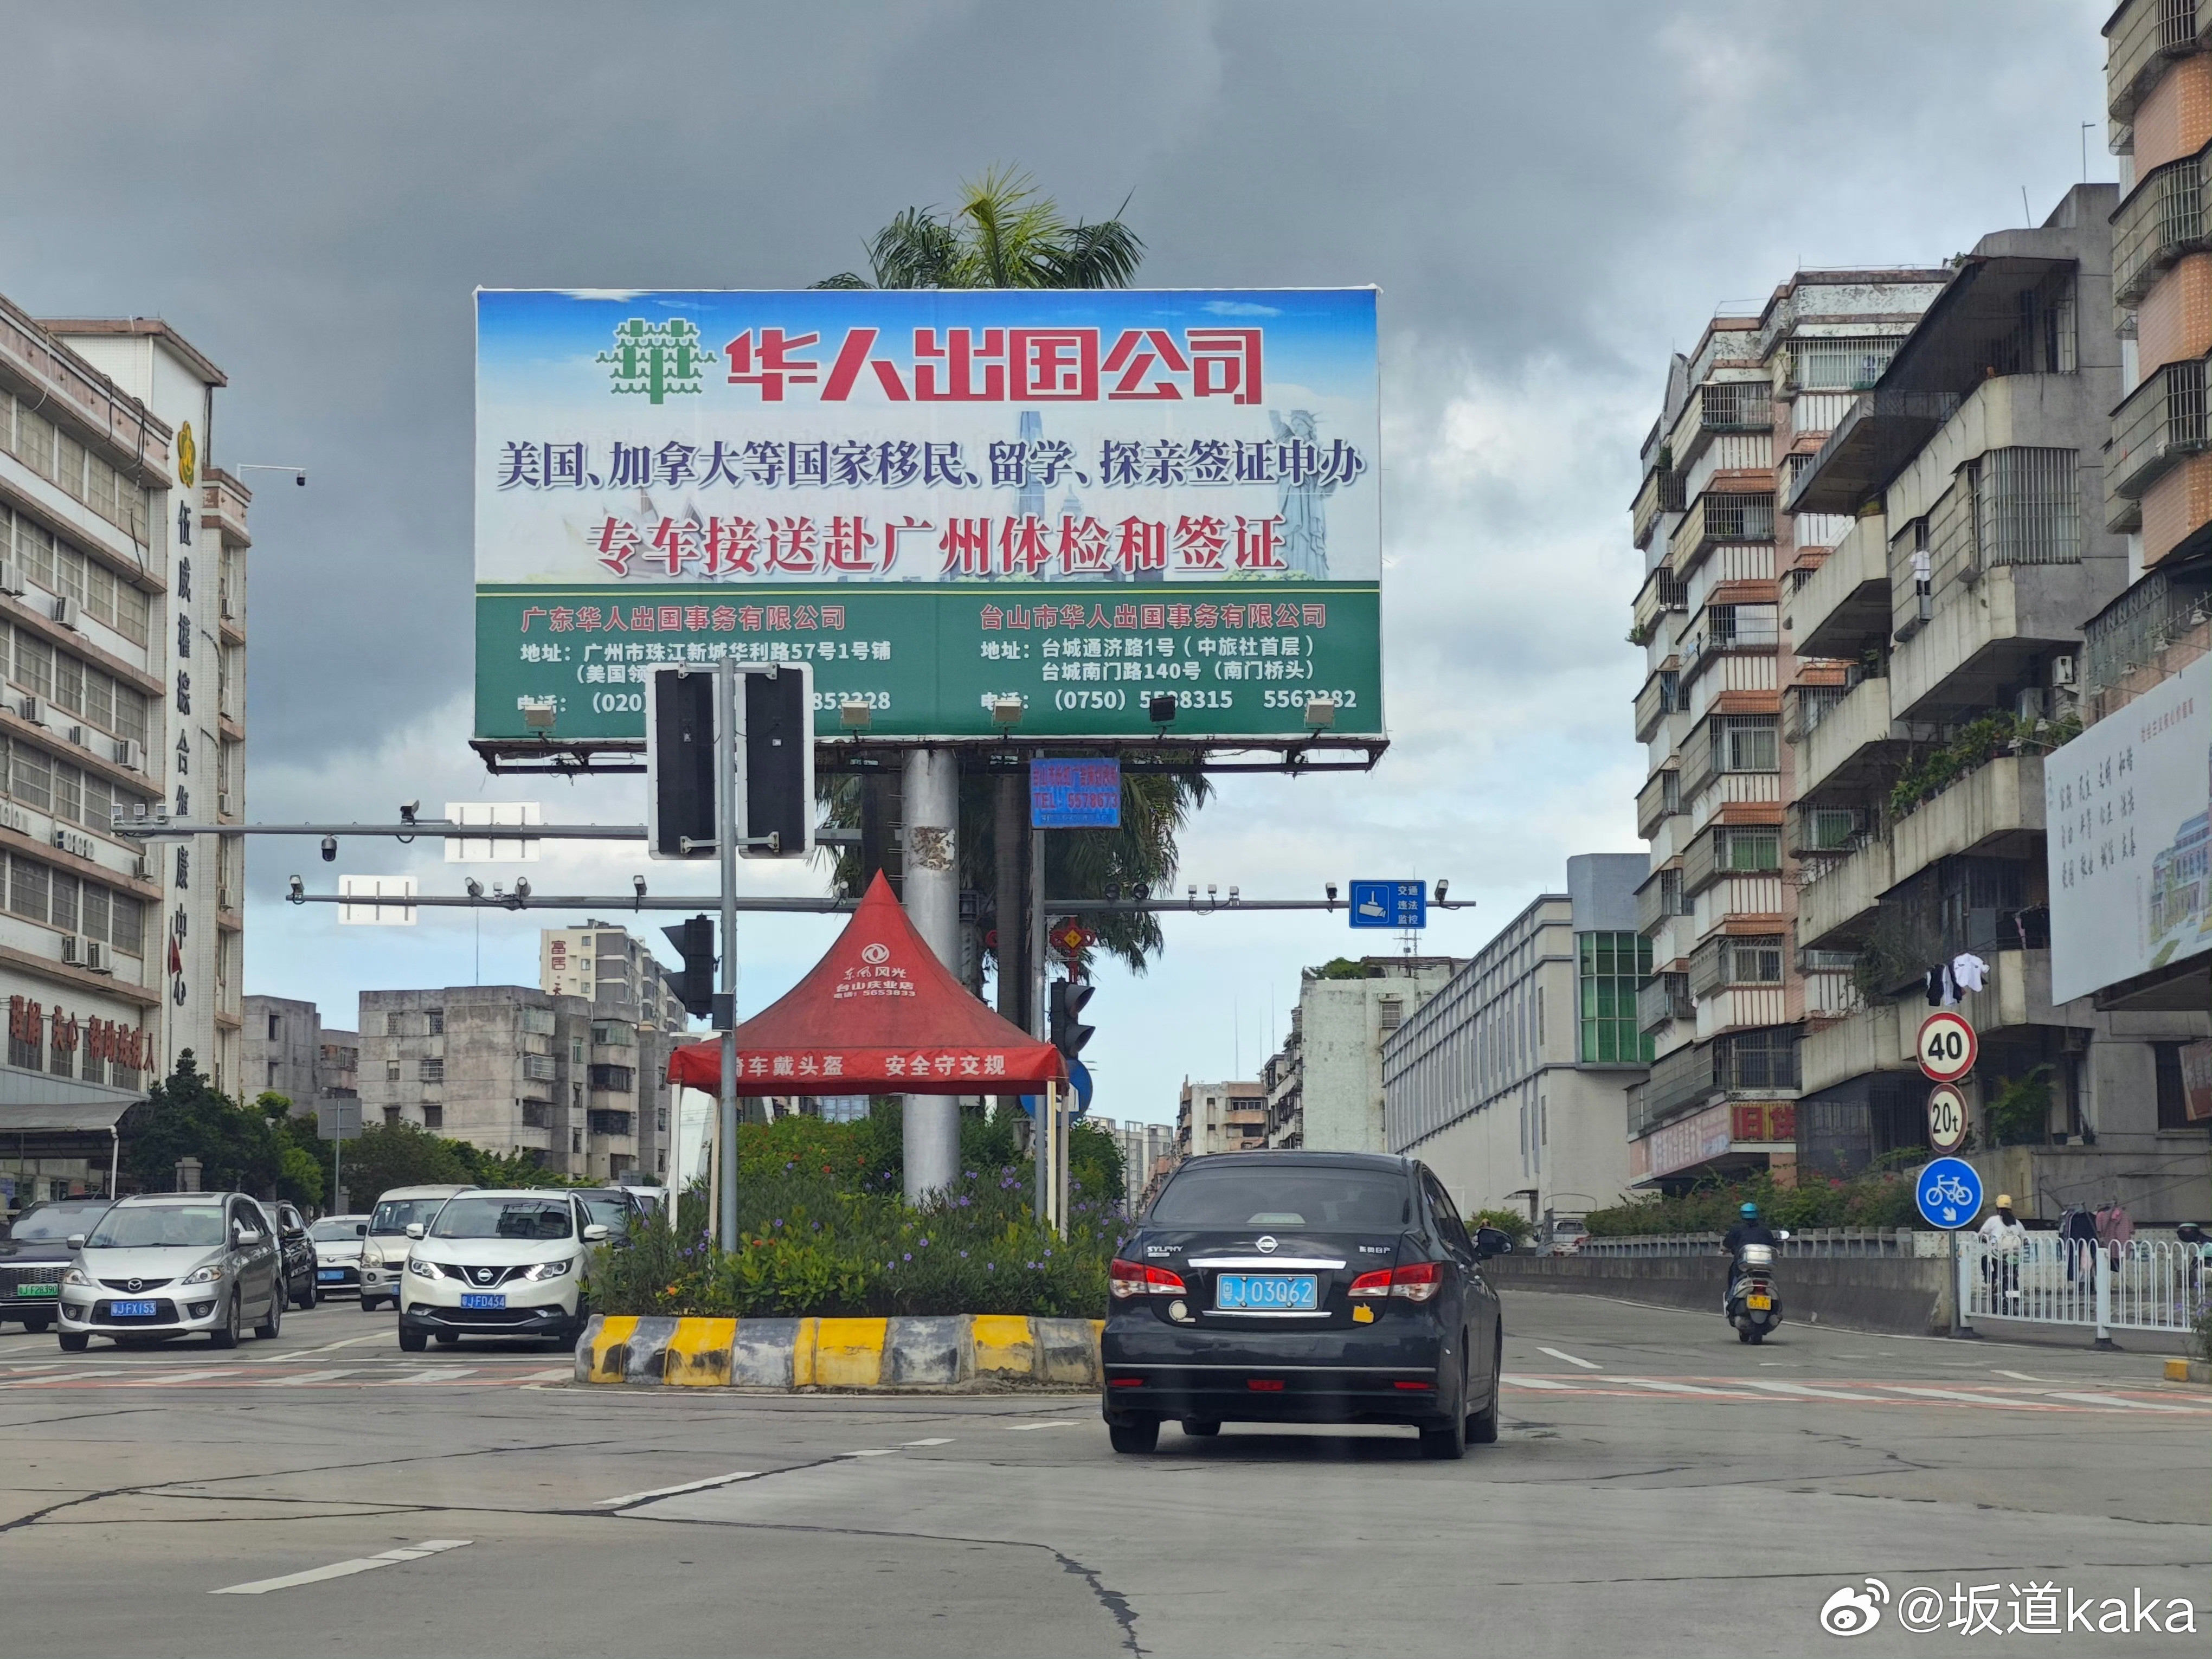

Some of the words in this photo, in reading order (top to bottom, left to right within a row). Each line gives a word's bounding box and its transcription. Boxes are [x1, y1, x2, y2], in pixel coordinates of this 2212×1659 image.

[725, 328, 1262, 404] 华人出国公司
[497, 439, 1365, 489] 美国、加拿大等国家移民、留学、探亲签证申办
[588, 515, 1287, 577] 专车接送赴广州体检和签证
[520, 605, 846, 632] 广东华人出国事务有限公司
[980, 603, 1326, 630] 台山市华人出国事务有限公司
[1397, 885, 1418, 896] 交通
[1397, 900, 1418, 910] 违法
[1397, 915, 1418, 924] 监控
[1928, 1031, 1962, 1060] 40
[885, 1055, 1006, 1076] 安全守交规
[1933, 1103, 1958, 1134] 20t
